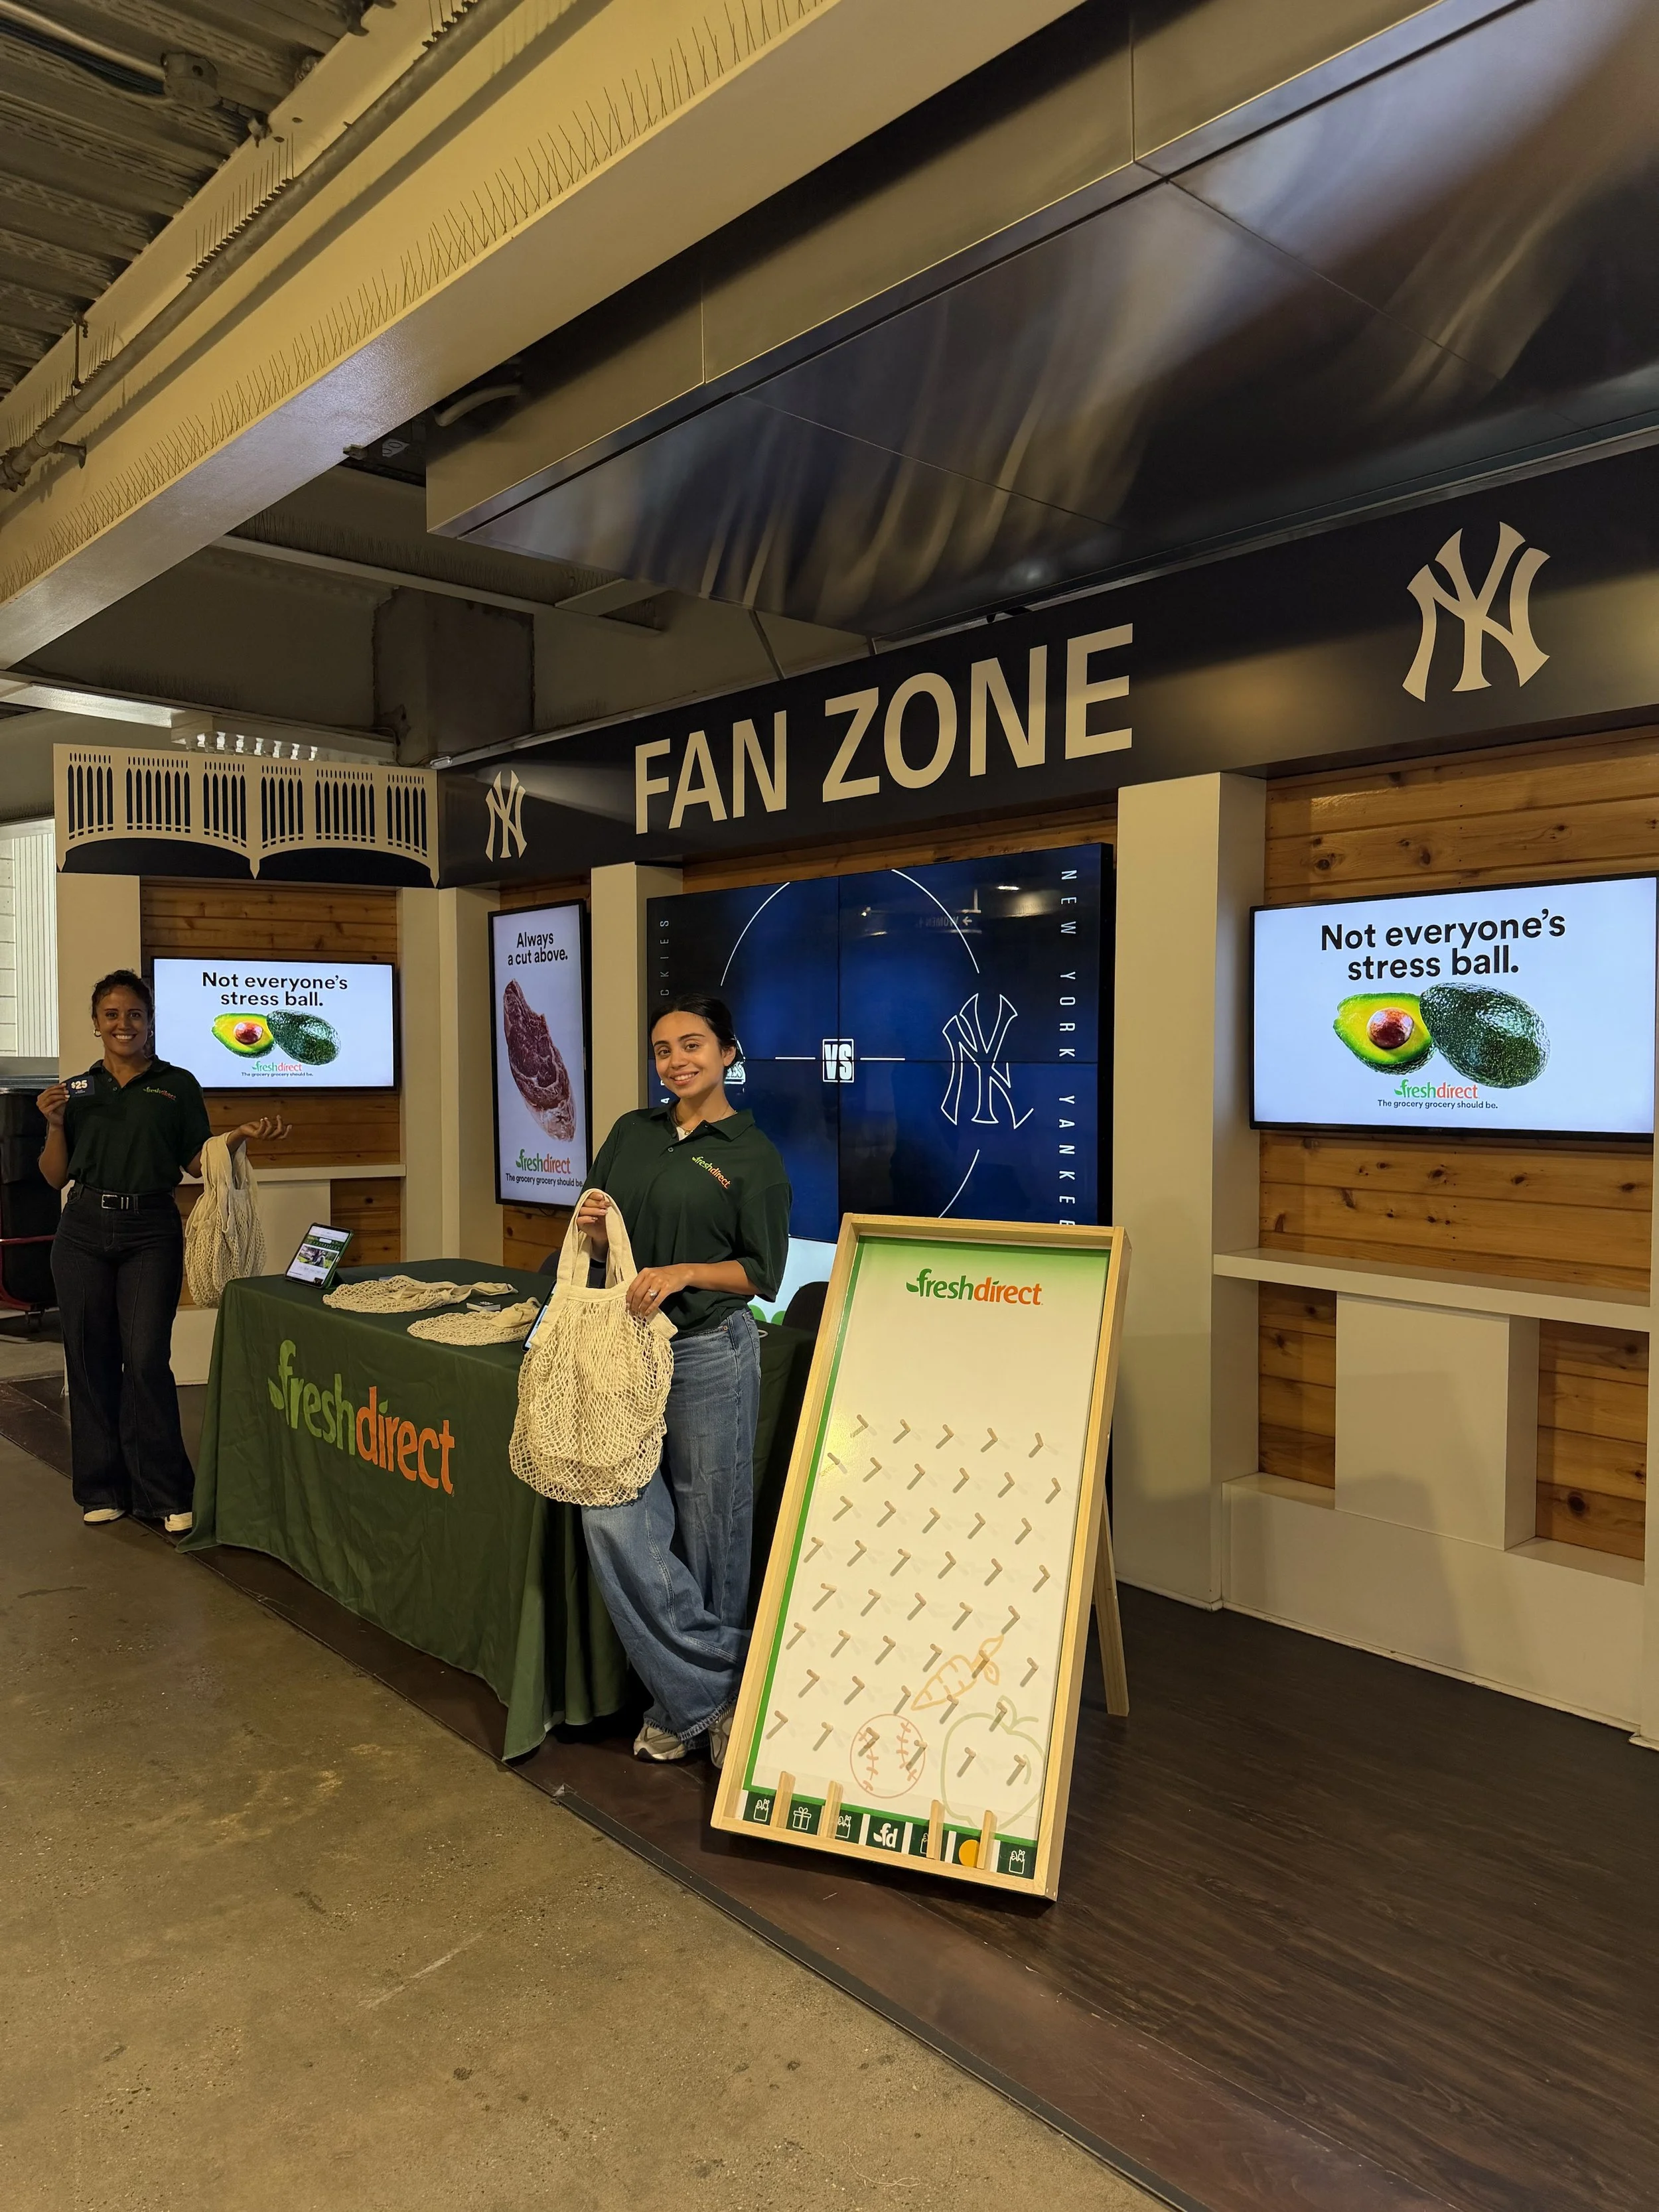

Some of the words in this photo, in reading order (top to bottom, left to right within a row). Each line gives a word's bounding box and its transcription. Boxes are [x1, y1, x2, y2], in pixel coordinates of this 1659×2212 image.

[634, 709, 787, 835] FAN
[822, 623, 1133, 803] ZONE
[1060, 870, 1077, 934] NEW
[516, 932, 554, 949] Always
[1321, 924, 1376, 951] Not
[1386, 908, 1565, 949] everyone’s
[508, 954, 514, 965] a
[516, 949, 532, 965] cut
[534, 947, 568, 963] above.
[660, 920, 670, 996] CKIES
[1348, 955, 1441, 981] stress
[1451, 944, 1519, 975] ball.
[202, 972, 239, 987] Not
[244, 975, 348, 992] everyone’s
[220, 991, 279, 1006] stress
[285, 991, 323, 1006] ball.
[1059, 971, 1076, 1057] YORK
[252, 1061, 303, 1072] freshdirect
[824, 1043, 852, 1080] VS
[71, 1079, 88, 1089] $25
[143, 1086, 177, 1101] freshdirect
[1394, 1079, 1479, 1099] freshdirect
[1394, 1101, 1423, 1109] grocery
[1425, 1101, 1455, 1110] grocery
[516, 1148, 571, 1174] freshdirect
[692, 1156, 731, 1189] freshdirect
[1058, 1095, 1075, 1225] YANKEE
[506, 1173, 516, 1182] The
[516, 1175, 536, 1185] grocery
[536, 1177, 556, 1187] grocery
[557, 1178, 575, 1187] should
[906, 1268, 1043, 1306] freshdirect
[267, 1340, 455, 1494] freshdirect
[879, 1823, 899, 1848] fd
